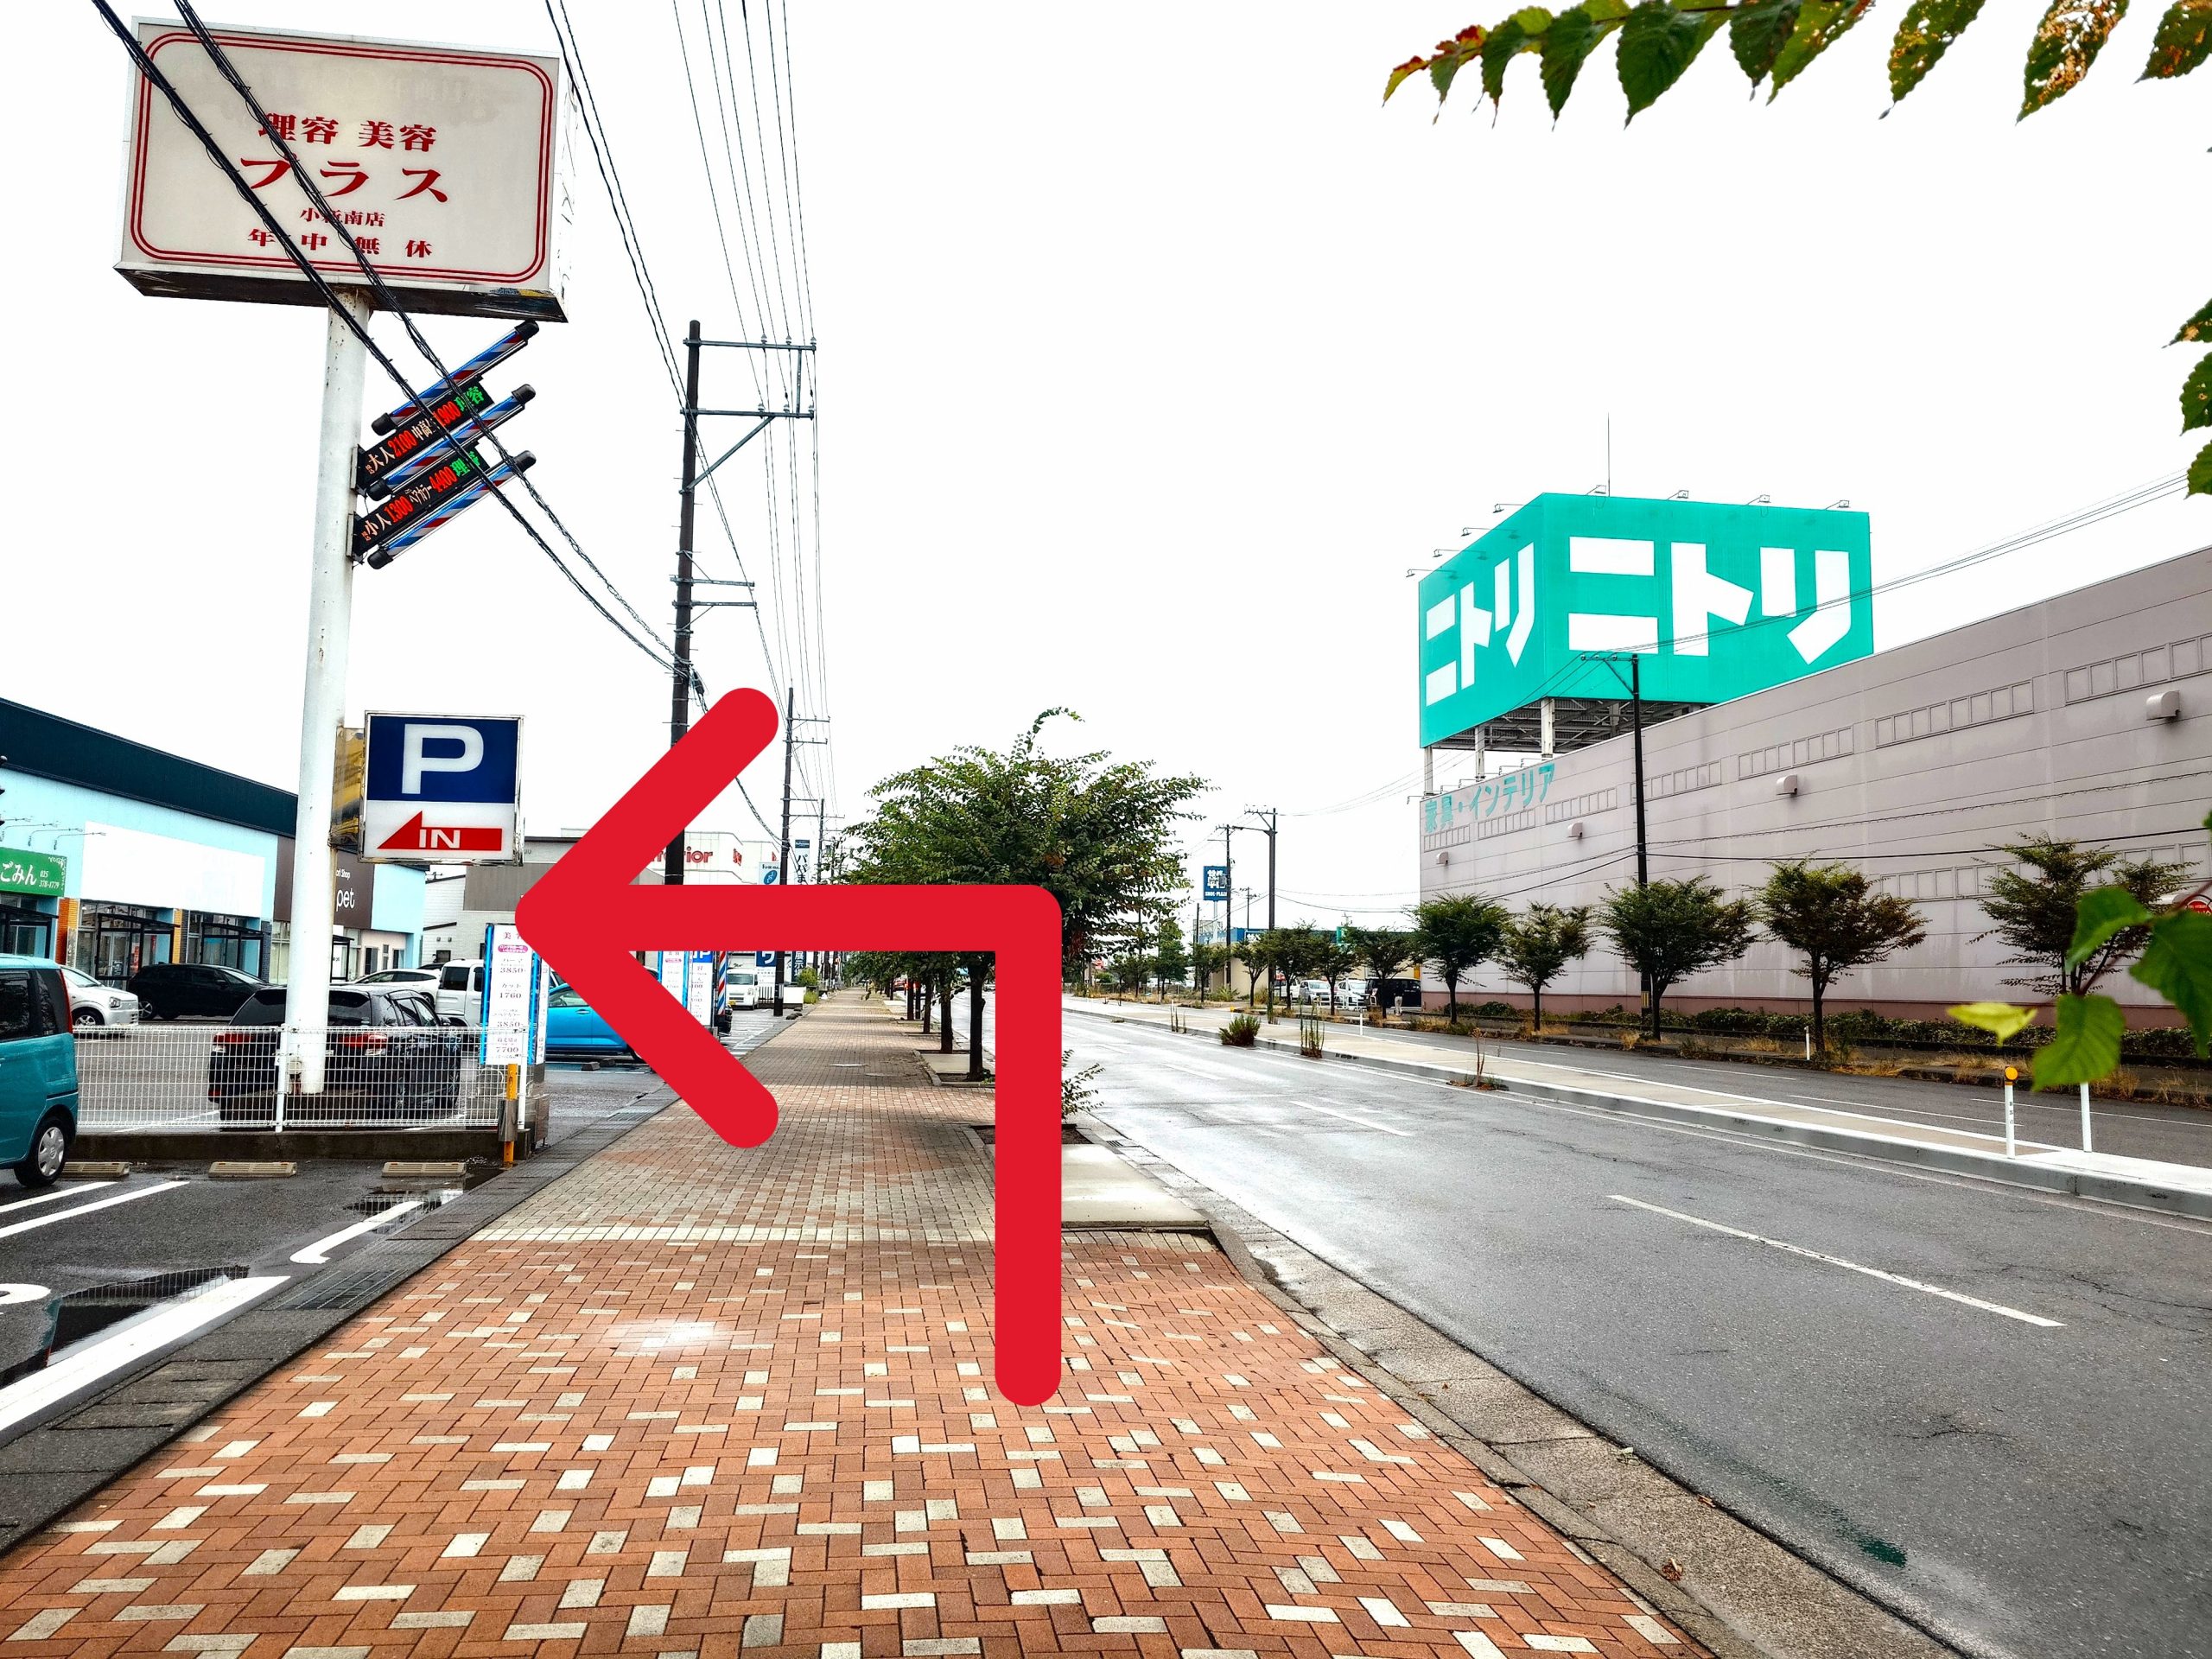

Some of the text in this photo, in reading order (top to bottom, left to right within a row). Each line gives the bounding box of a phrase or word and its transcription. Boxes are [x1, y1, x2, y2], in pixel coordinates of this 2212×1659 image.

[358, 121, 436, 152] 美容
[240, 152, 448, 203] プラス
[247, 228, 433, 258] 年中無休
[1426, 541, 1535, 707] ニトリ
[1568, 536, 1852, 665] ニトリ
[402, 723, 484, 794] P
[1425, 763, 1554, 833] 家具・インテリア
[419, 829, 461, 849] IN
